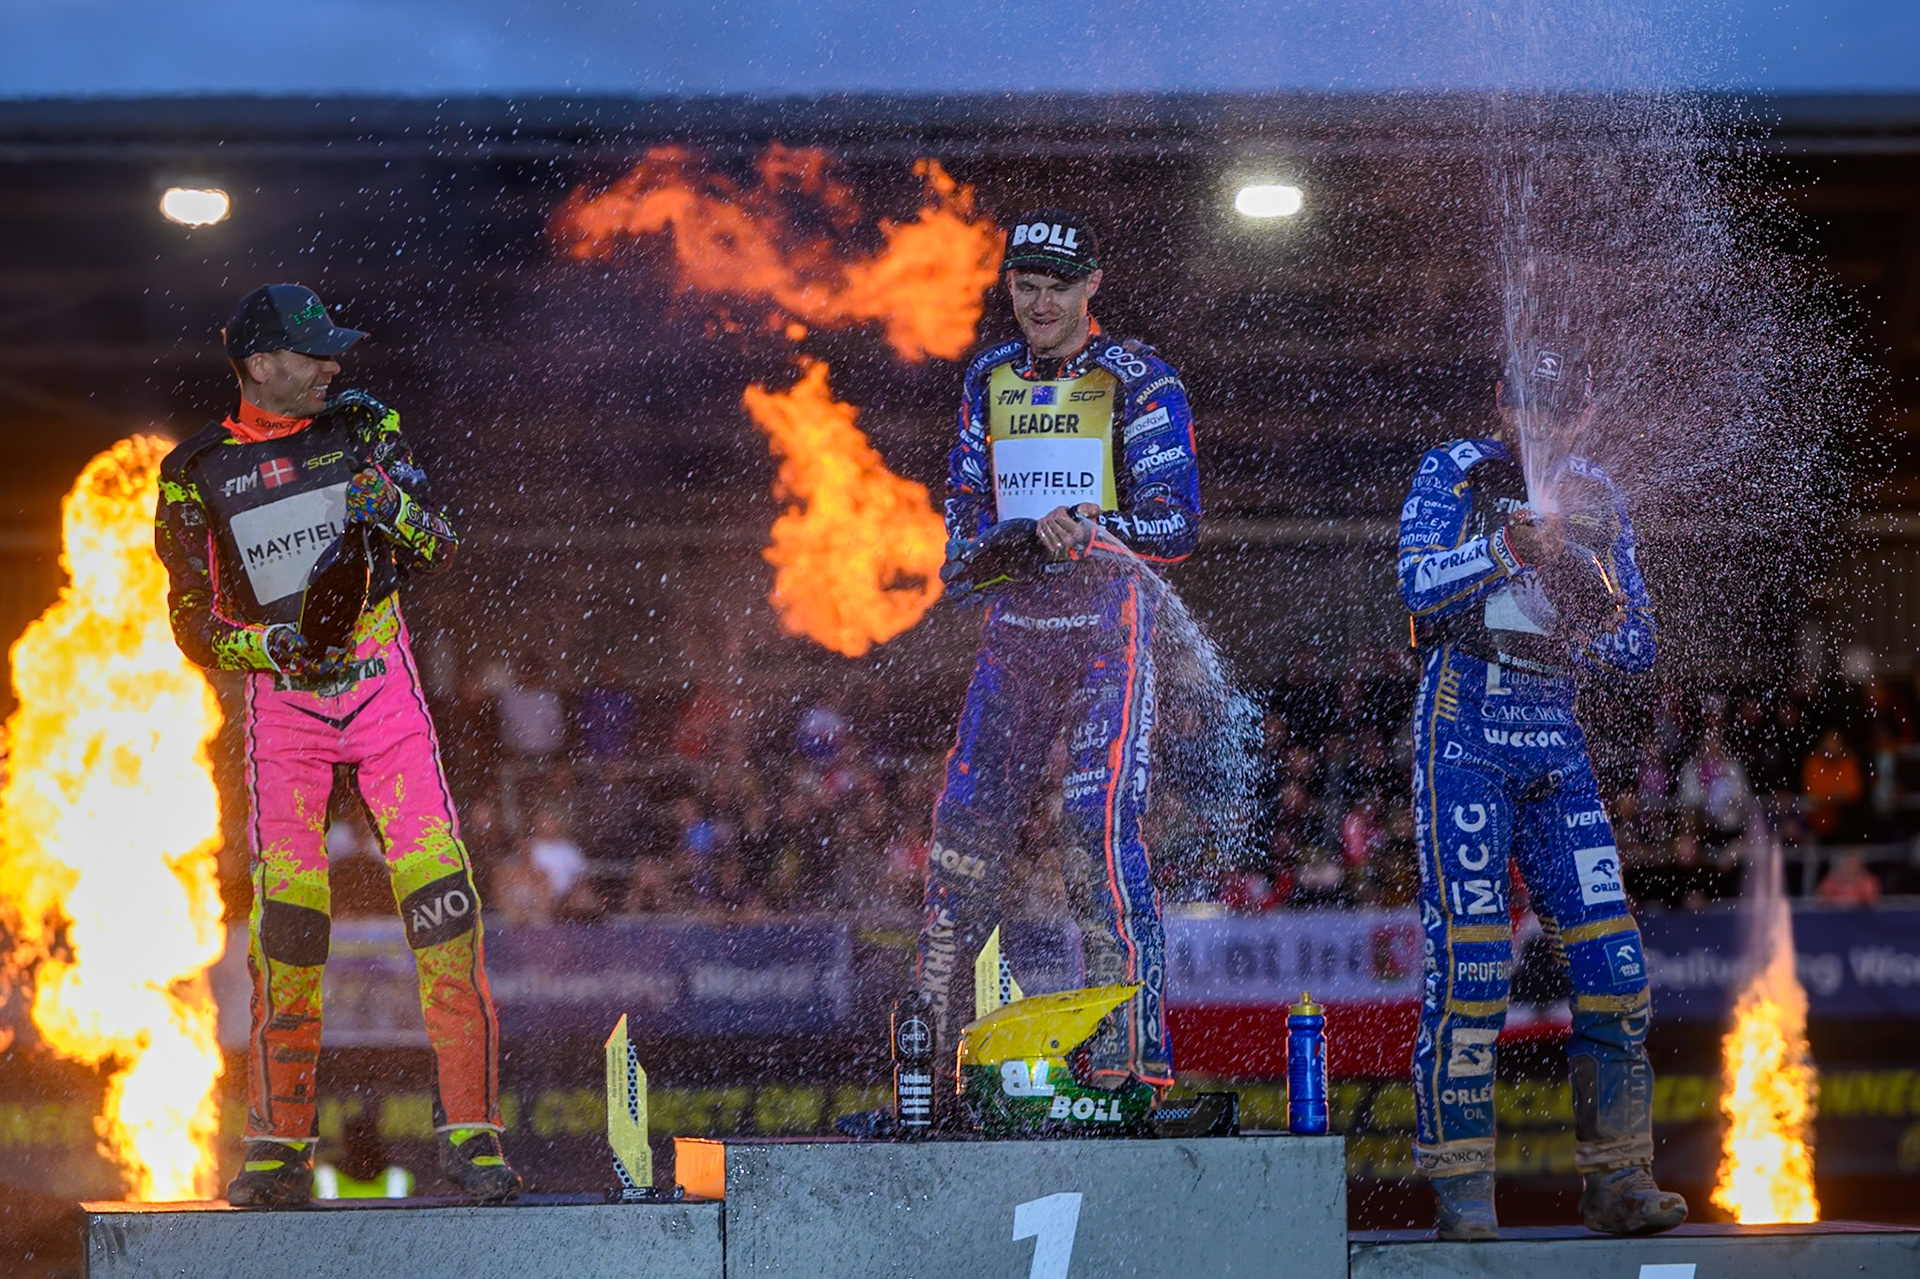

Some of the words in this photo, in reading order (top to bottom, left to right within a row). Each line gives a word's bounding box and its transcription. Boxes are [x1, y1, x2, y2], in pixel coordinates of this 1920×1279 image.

[1012, 222, 1078, 249] BOLL
[996, 389, 1027, 406] FIM
[1069, 391, 1105, 402] SGP
[1010, 414, 1080, 434] LEADER
[307, 451, 343, 469] SGP
[221, 470, 257, 497] FIM
[998, 472, 1094, 490] MAYFIELD
[246, 518, 346, 563] MAYFIEL
[902, 1031, 926, 1046] petit
[1049, 1096, 1122, 1121] BOLL
[1012, 1192, 1083, 1279] 1
